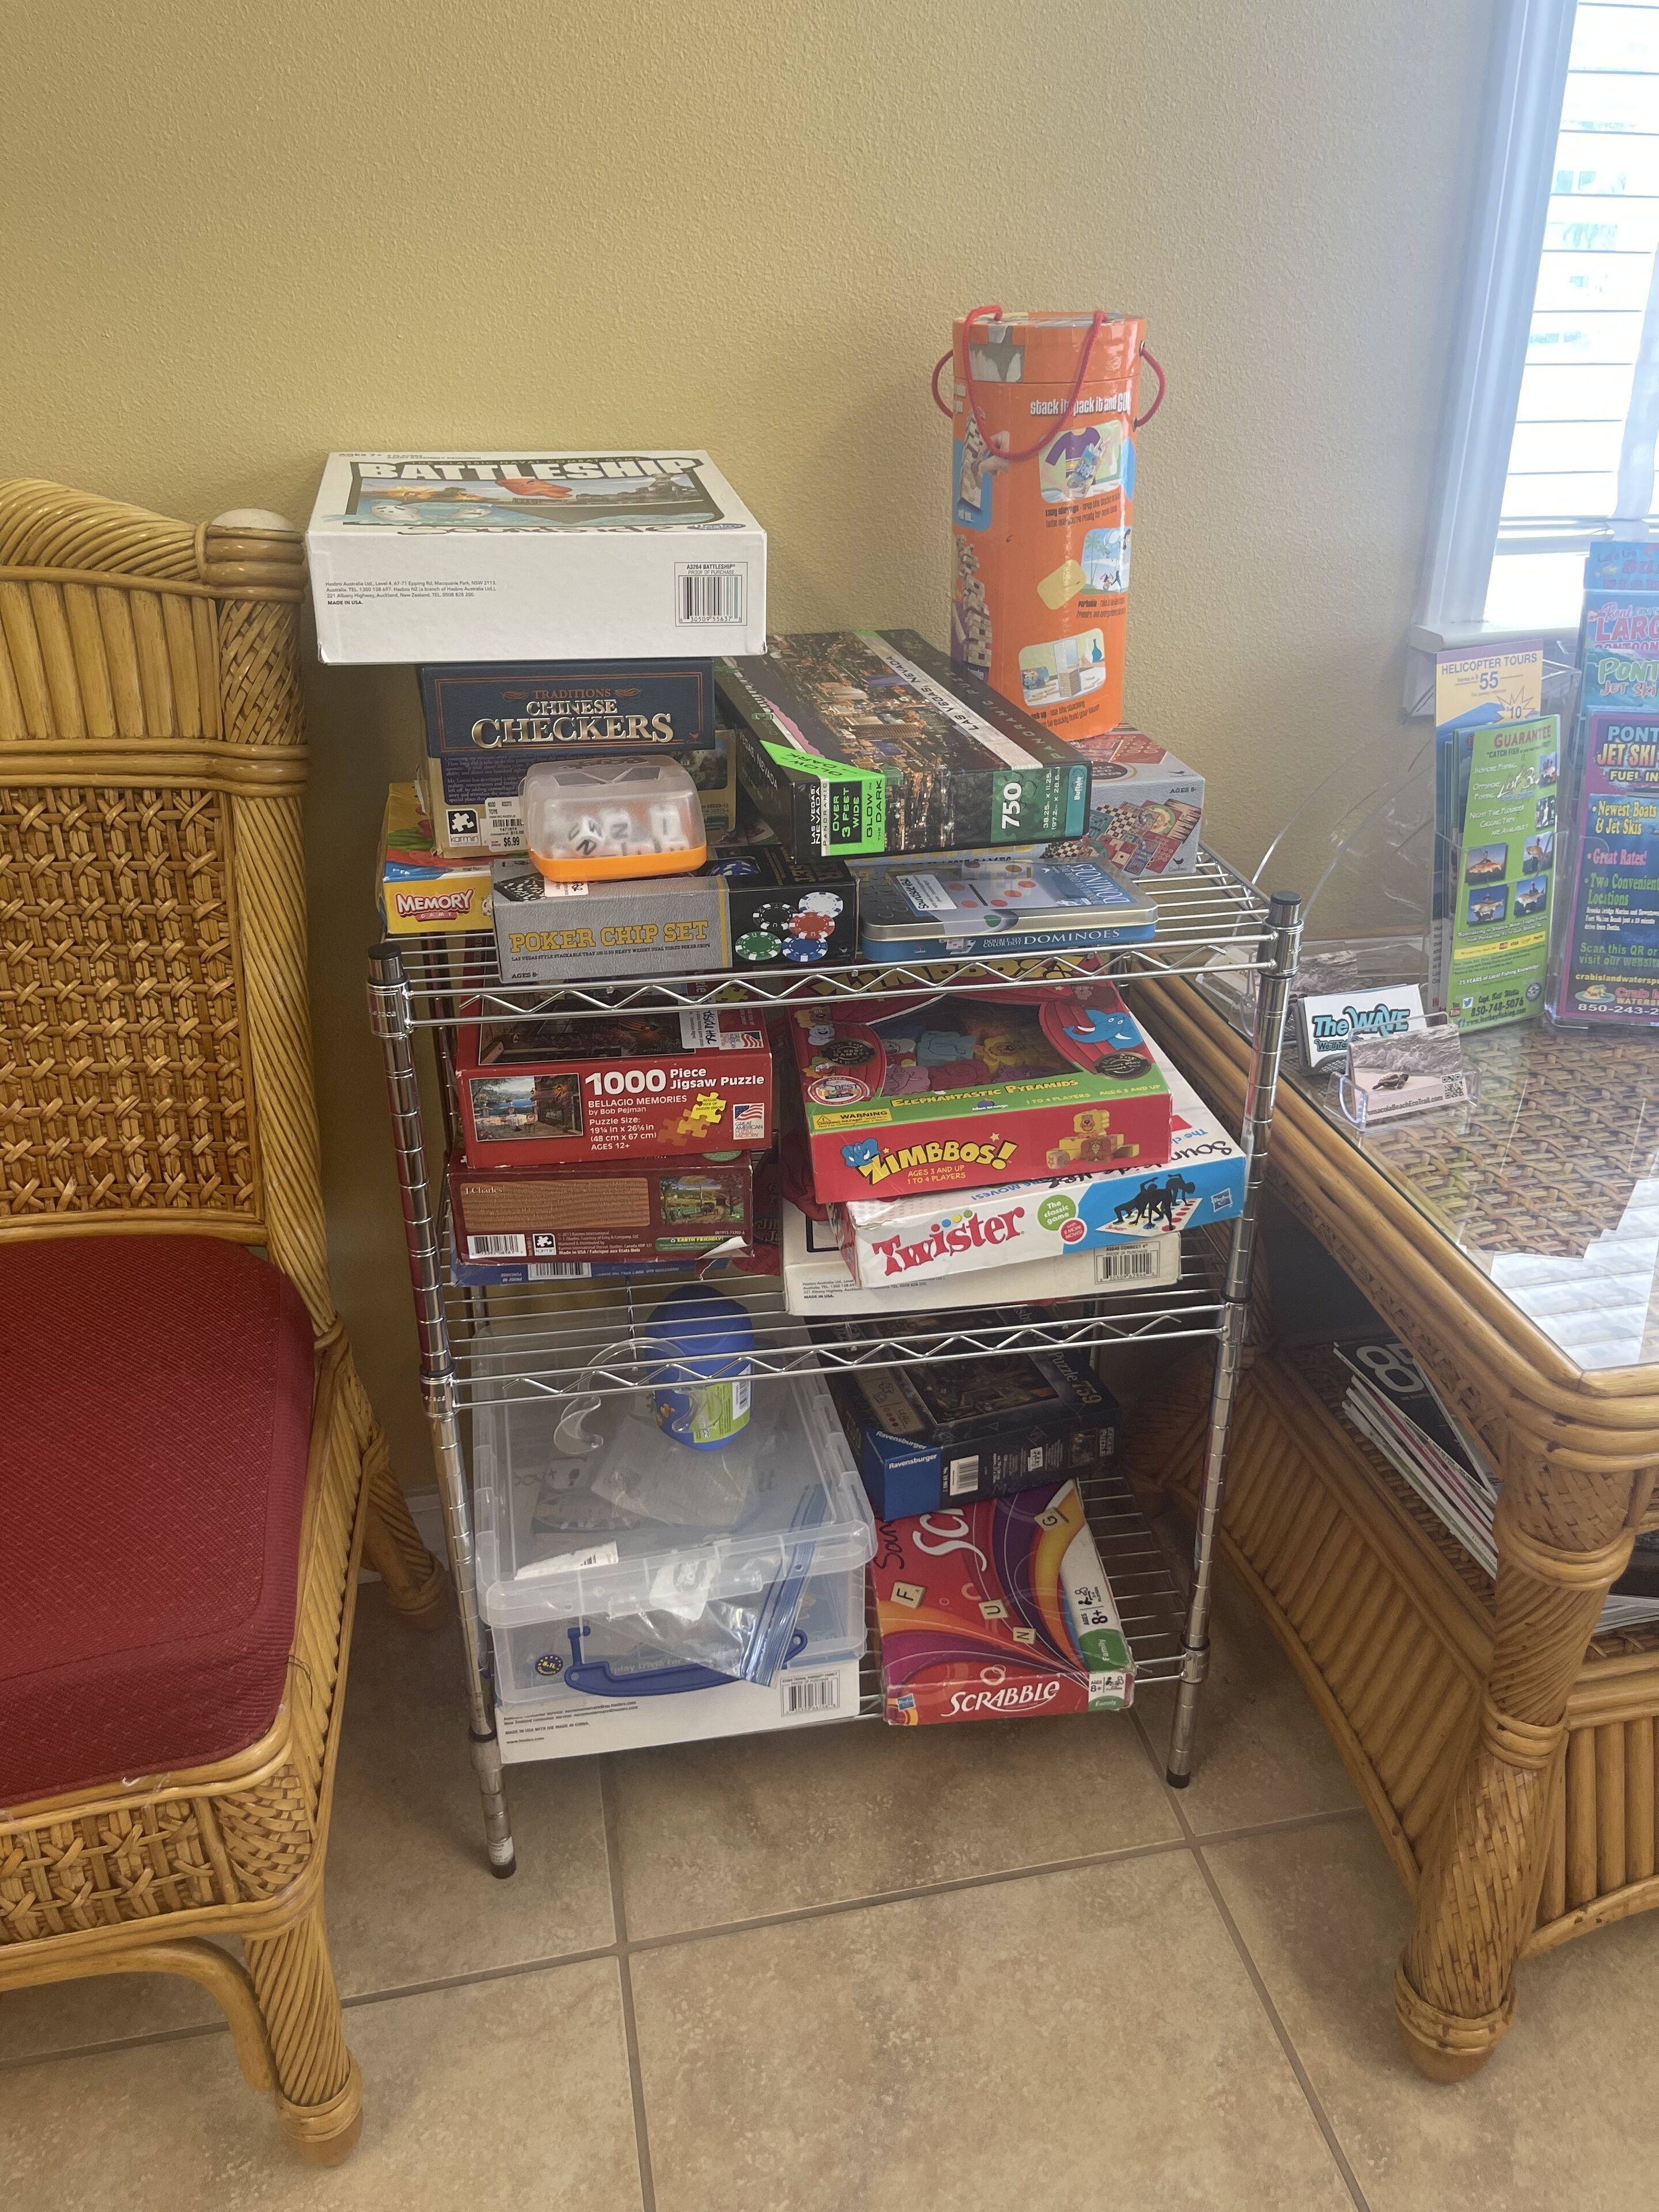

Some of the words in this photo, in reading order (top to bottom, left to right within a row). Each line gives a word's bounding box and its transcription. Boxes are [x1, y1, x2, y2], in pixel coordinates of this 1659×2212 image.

[1031, 399, 1058, 415] stack
[1073, 397, 1094, 416] pack
[1096, 396, 1104, 411] it
[1104, 393, 1117, 411] and
[358, 459, 699, 480] BATTLESHIP
[885, 656, 921, 684] NEVADA
[1441, 657, 1501, 676] HELICOPTER
[1503, 652, 1537, 667] TOURS
[1479, 671, 1499, 691] 55
[1600, 680, 1630, 696] JET
[533, 688, 611, 699] TRADITIONS
[527, 699, 618, 716] CHINESE
[471, 713, 675, 748] CHECKERS
[954, 714, 979, 731] LAS
[1493, 725, 1551, 748] GUARANTEE
[1508, 748, 1519, 756] FISH
[1597, 743, 1626, 766] JET
[1628, 743, 1656, 767] SKI
[756, 756, 778, 791] NEVADA
[1609, 771, 1641, 781] FUEL
[1074, 776, 1082, 801] Buffalo
[1001, 782, 1022, 830] 750
[1597, 800, 1630, 817] Newest
[1633, 801, 1657, 818] Boats
[842, 826, 851, 838] 3
[1596, 817, 1603, 834] &
[1605, 818, 1621, 835] Jet
[1622, 817, 1642, 835] Skis
[450, 835, 479, 843] karmin
[503, 836, 520, 847] $6.99
[1593, 847, 1618, 865] Great
[1620, 848, 1647, 866] Rates!
[1590, 872, 1609, 889] Two
[396, 889, 473, 914] MEMORY
[1588, 889, 1629, 906] Locations
[509, 927, 596, 953] POKER
[600, 923, 659, 946] CHIP
[663, 920, 709, 943] SET
[1024, 928, 1120, 945] DOMINOES
[1580, 942, 1605, 953] Scan
[1608, 943, 1627, 955] this
[1630, 944, 1644, 956] QR
[1580, 954, 1600, 964] visit
[1604, 955, 1620, 965] our
[1466, 976, 1482, 984] YEARS
[1488, 972, 1501, 980] Local
[1501, 968, 1516, 978] Fishing
[1471, 996, 1524, 1017] 850-748-5076
[1312, 1014, 1349, 1037] The
[1343, 1003, 1410, 1037] WAVE
[585, 1069, 666, 1096] 1000
[670, 1067, 707, 1078] Piece
[670, 1078, 717, 1090] Jigsaw
[721, 1075, 765, 1087] Puzzle
[891, 1088, 1002, 1107] ELEPHANTASTIC
[1005, 1078, 1080, 1094] PYRAMIDS
[1052, 1093, 1091, 1101] PLAYERS
[588, 1098, 634, 1108] BELLAGIO
[636, 1095, 687, 1105] MEMORIES
[618, 1106, 646, 1115] Pejman
[840, 1111, 888, 1119] WARNING
[620, 1116, 641, 1124] Size:
[590, 1134, 604, 1143] (48
[641, 1132, 657, 1140] cm)
[858, 1139, 1019, 1186] ZIMBBOS!
[908, 1168, 929, 1177] AGES
[932, 1172, 967, 1181] PLAYERS
[1044, 1206, 1069, 1218] classic
[1047, 1200, 1062, 1209] The
[1047, 1212, 1070, 1225] game
[1068, 1225, 1081, 1233] MORE
[871, 1205, 1025, 1278] Twister
[1052, 1351, 1080, 1382] Puzzle
[1071, 1380, 1103, 1404] 759
[875, 1430, 927, 1450] Ravensburger
[888, 1453, 938, 1469] Ravensburger
[1042, 1516, 1058, 1527] G
[896, 1587, 915, 1602] F
[986, 1605, 1001, 1616] U
[1091, 1609, 1108, 1625] 8+
[1081, 1613, 1090, 1626] AGES
[1097, 1638, 1110, 1662] Family
[1090, 1684, 1102, 1692] 8+
[940, 1680, 1060, 1717] SCRABBLE
[1095, 1699, 1117, 1708] Family
